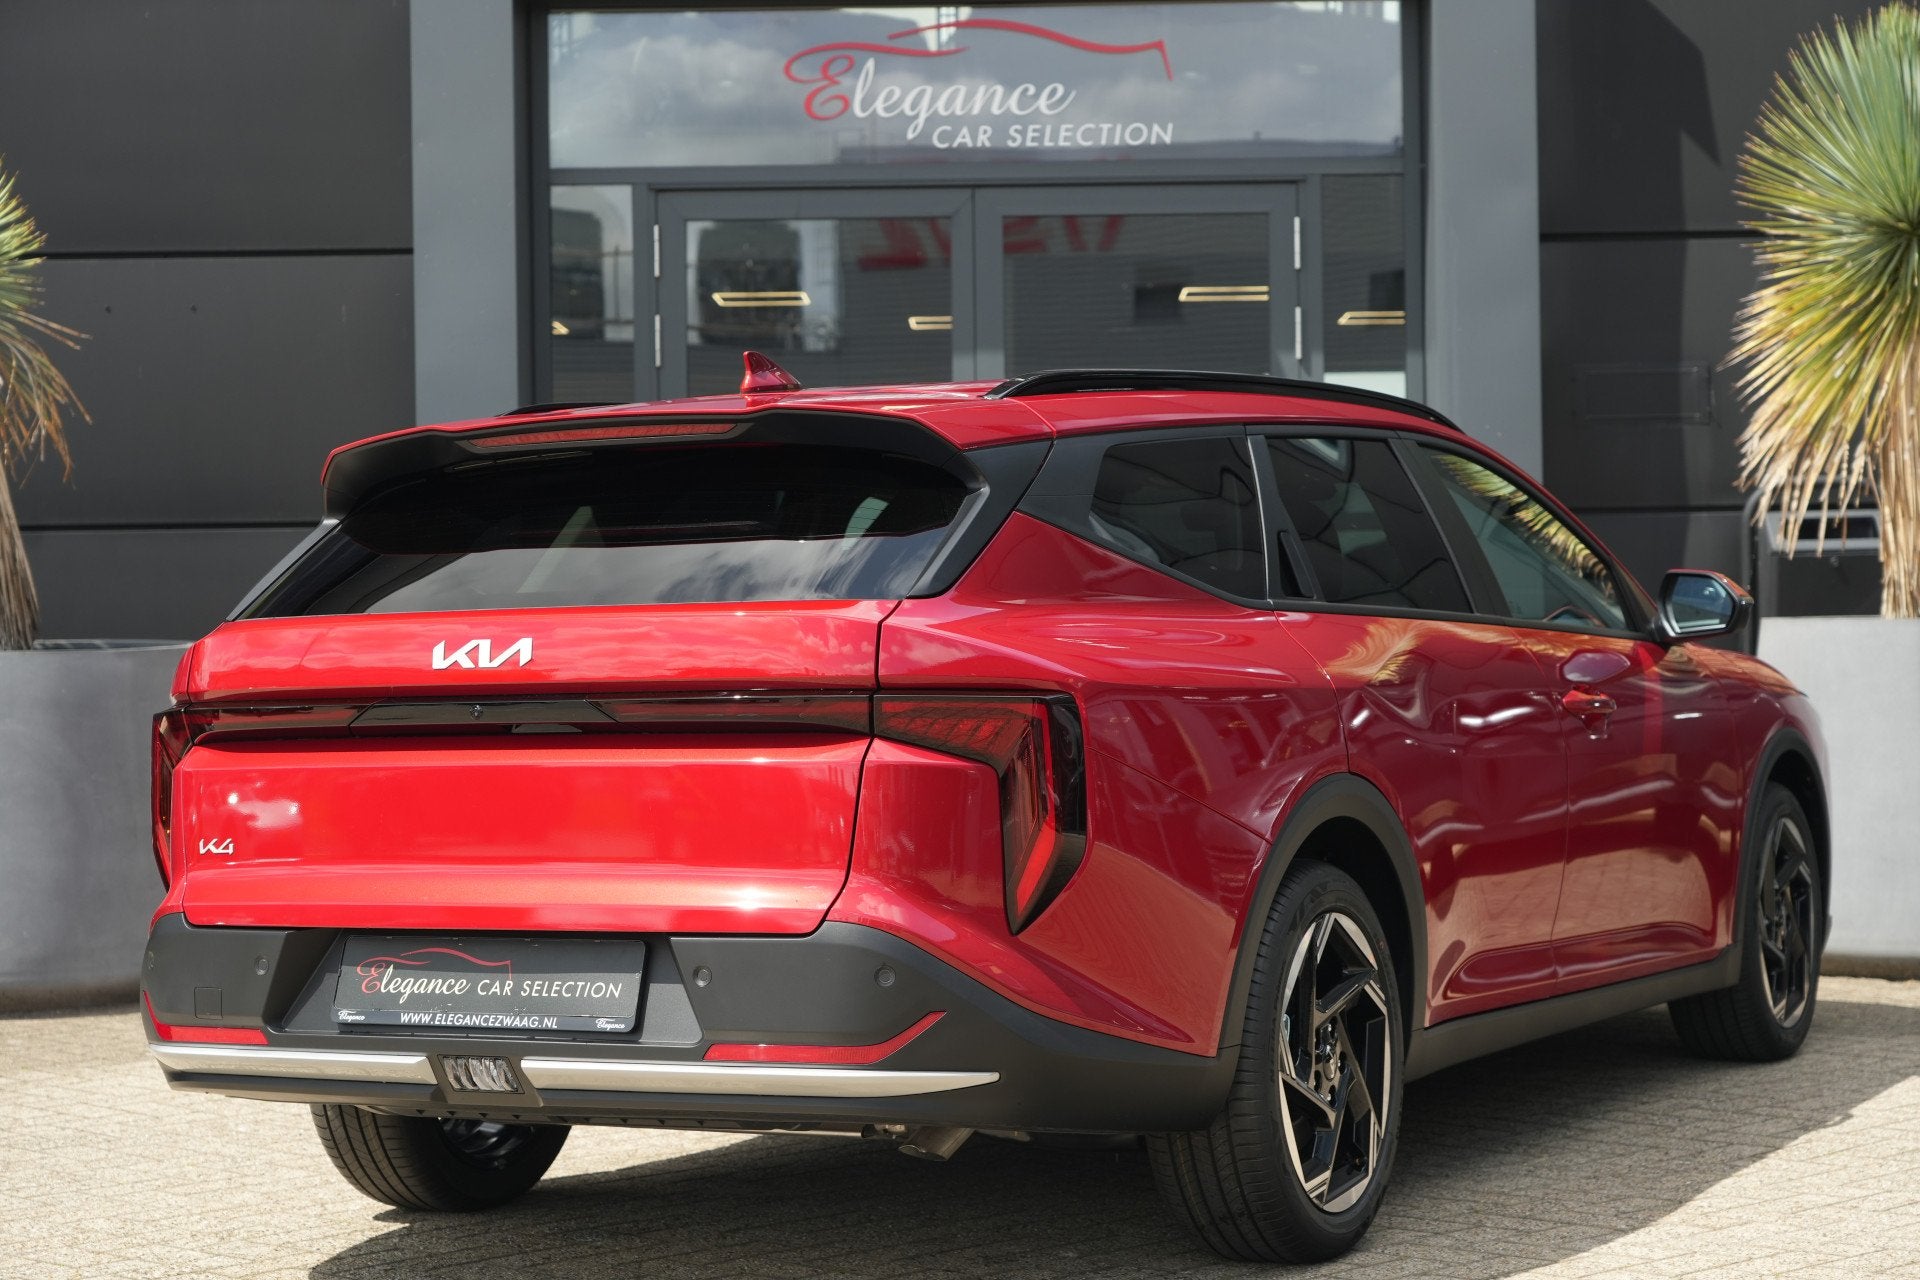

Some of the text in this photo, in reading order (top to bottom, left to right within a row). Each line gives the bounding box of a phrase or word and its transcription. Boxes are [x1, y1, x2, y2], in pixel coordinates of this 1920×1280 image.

[783, 44, 1077, 141] Elegance
[932, 121, 1174, 149] CAR SELECTION
[431, 637, 534, 670] KIA
[198, 838, 234, 856] K4
[356, 956, 622, 1004] Elegance CAR SELECTION
[400, 1012, 558, 1029] WWW.ELEGANCEZWAAG.NL
